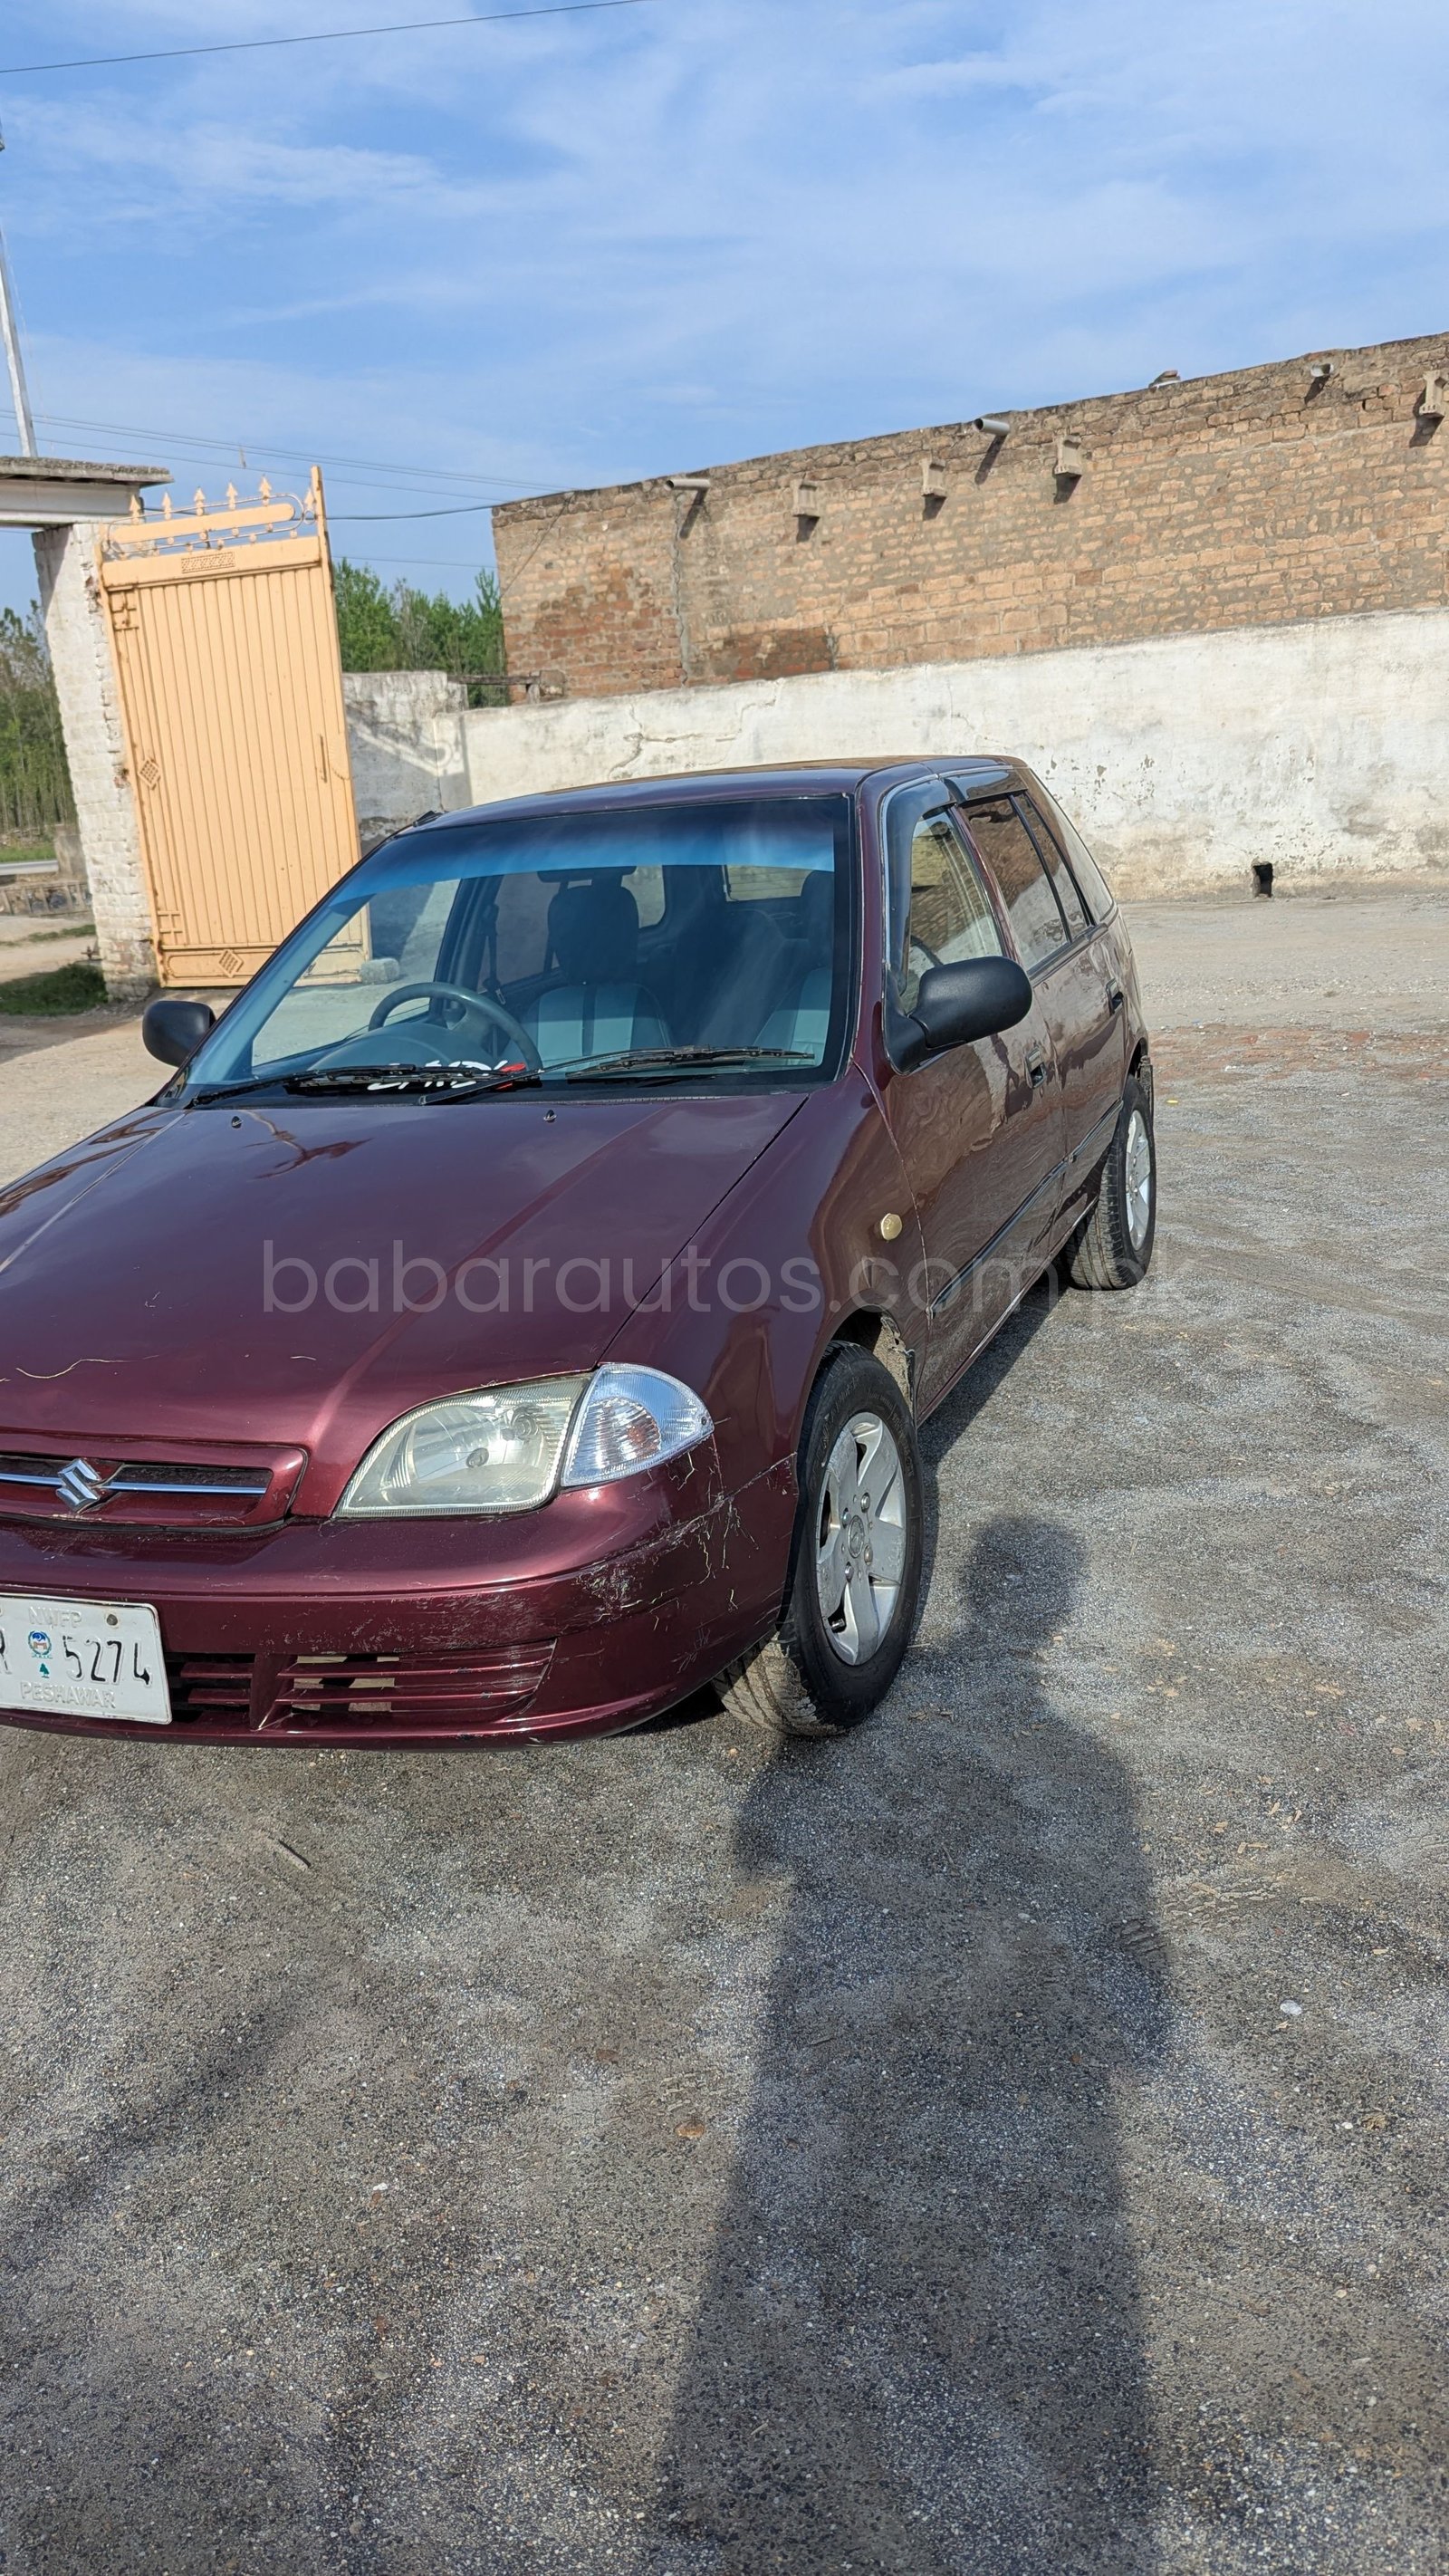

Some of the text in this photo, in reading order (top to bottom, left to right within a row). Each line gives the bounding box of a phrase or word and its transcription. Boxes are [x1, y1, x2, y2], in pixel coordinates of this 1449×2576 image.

[29, 1606, 82, 1629] NWFP
[62, 1634, 152, 1687] 5274
[20, 1681, 117, 1709] PESHAWAR
